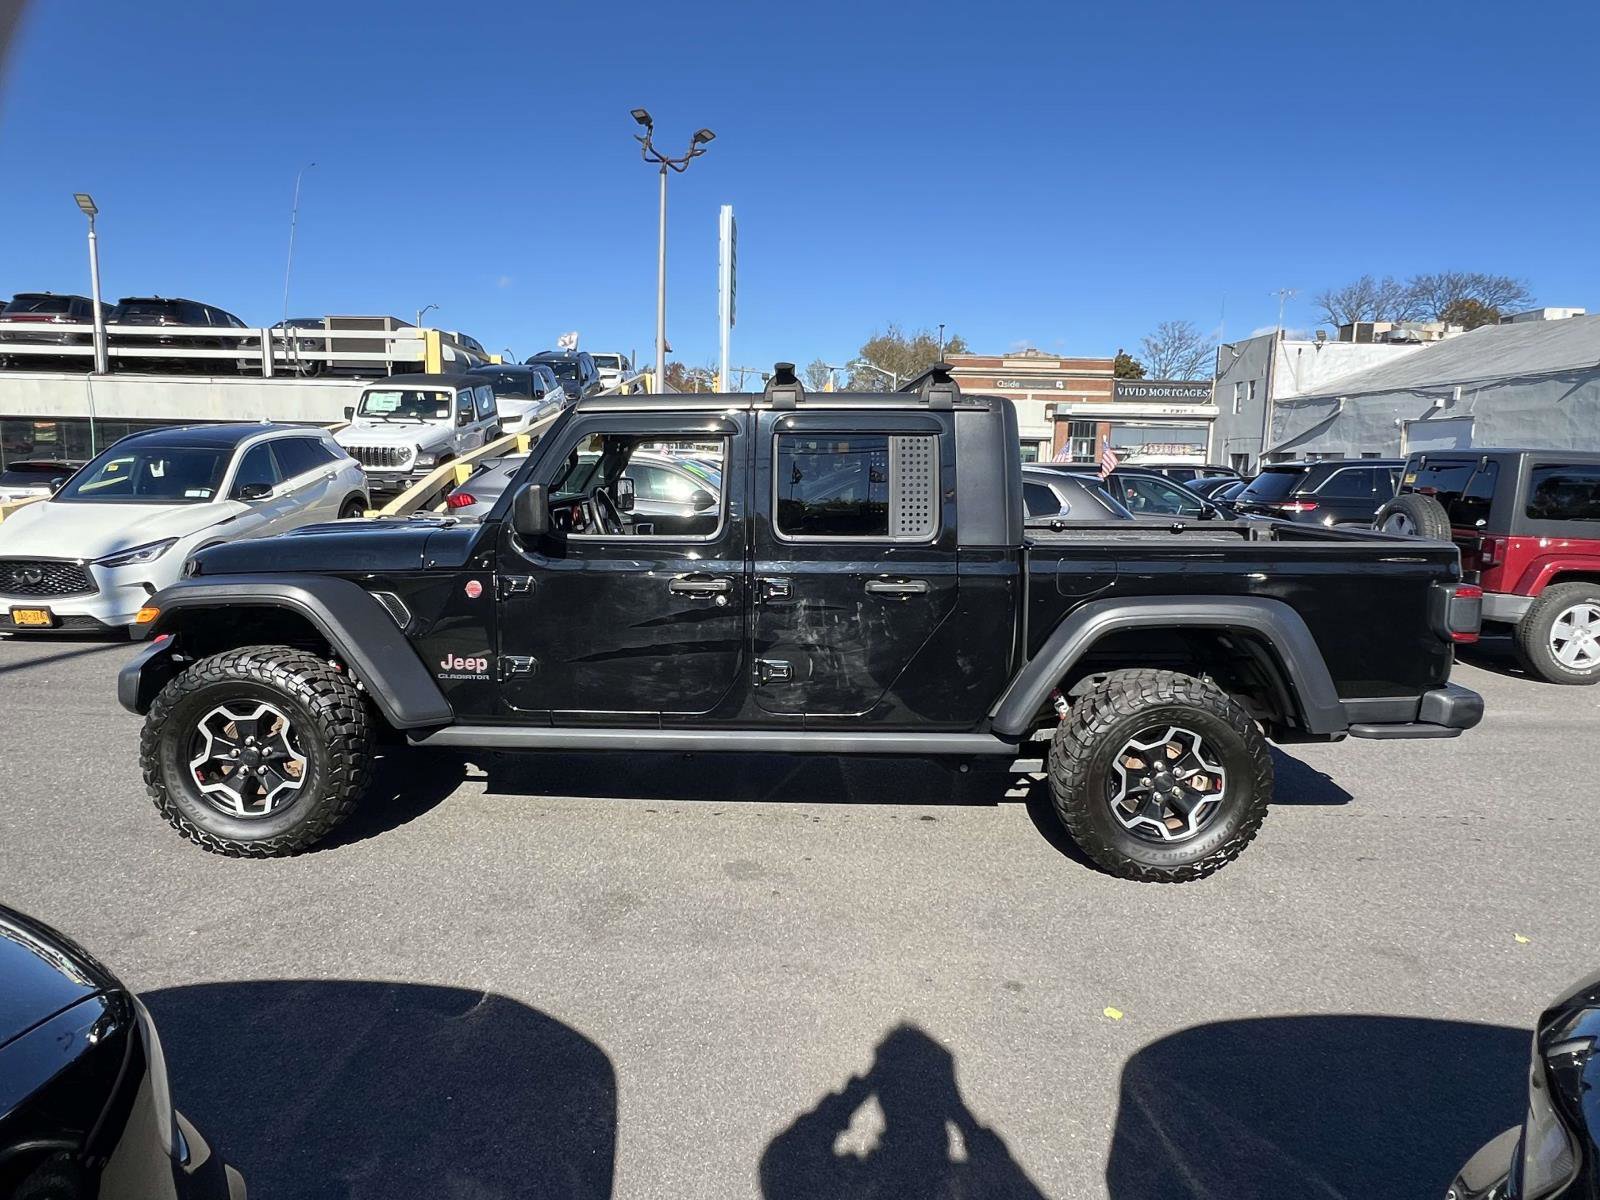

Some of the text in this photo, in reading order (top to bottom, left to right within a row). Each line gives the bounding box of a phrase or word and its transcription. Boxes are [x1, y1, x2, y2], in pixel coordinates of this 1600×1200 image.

[1117, 387, 1208, 398] VIVID MORTGAGES
[440, 653, 488, 674] Jeep
